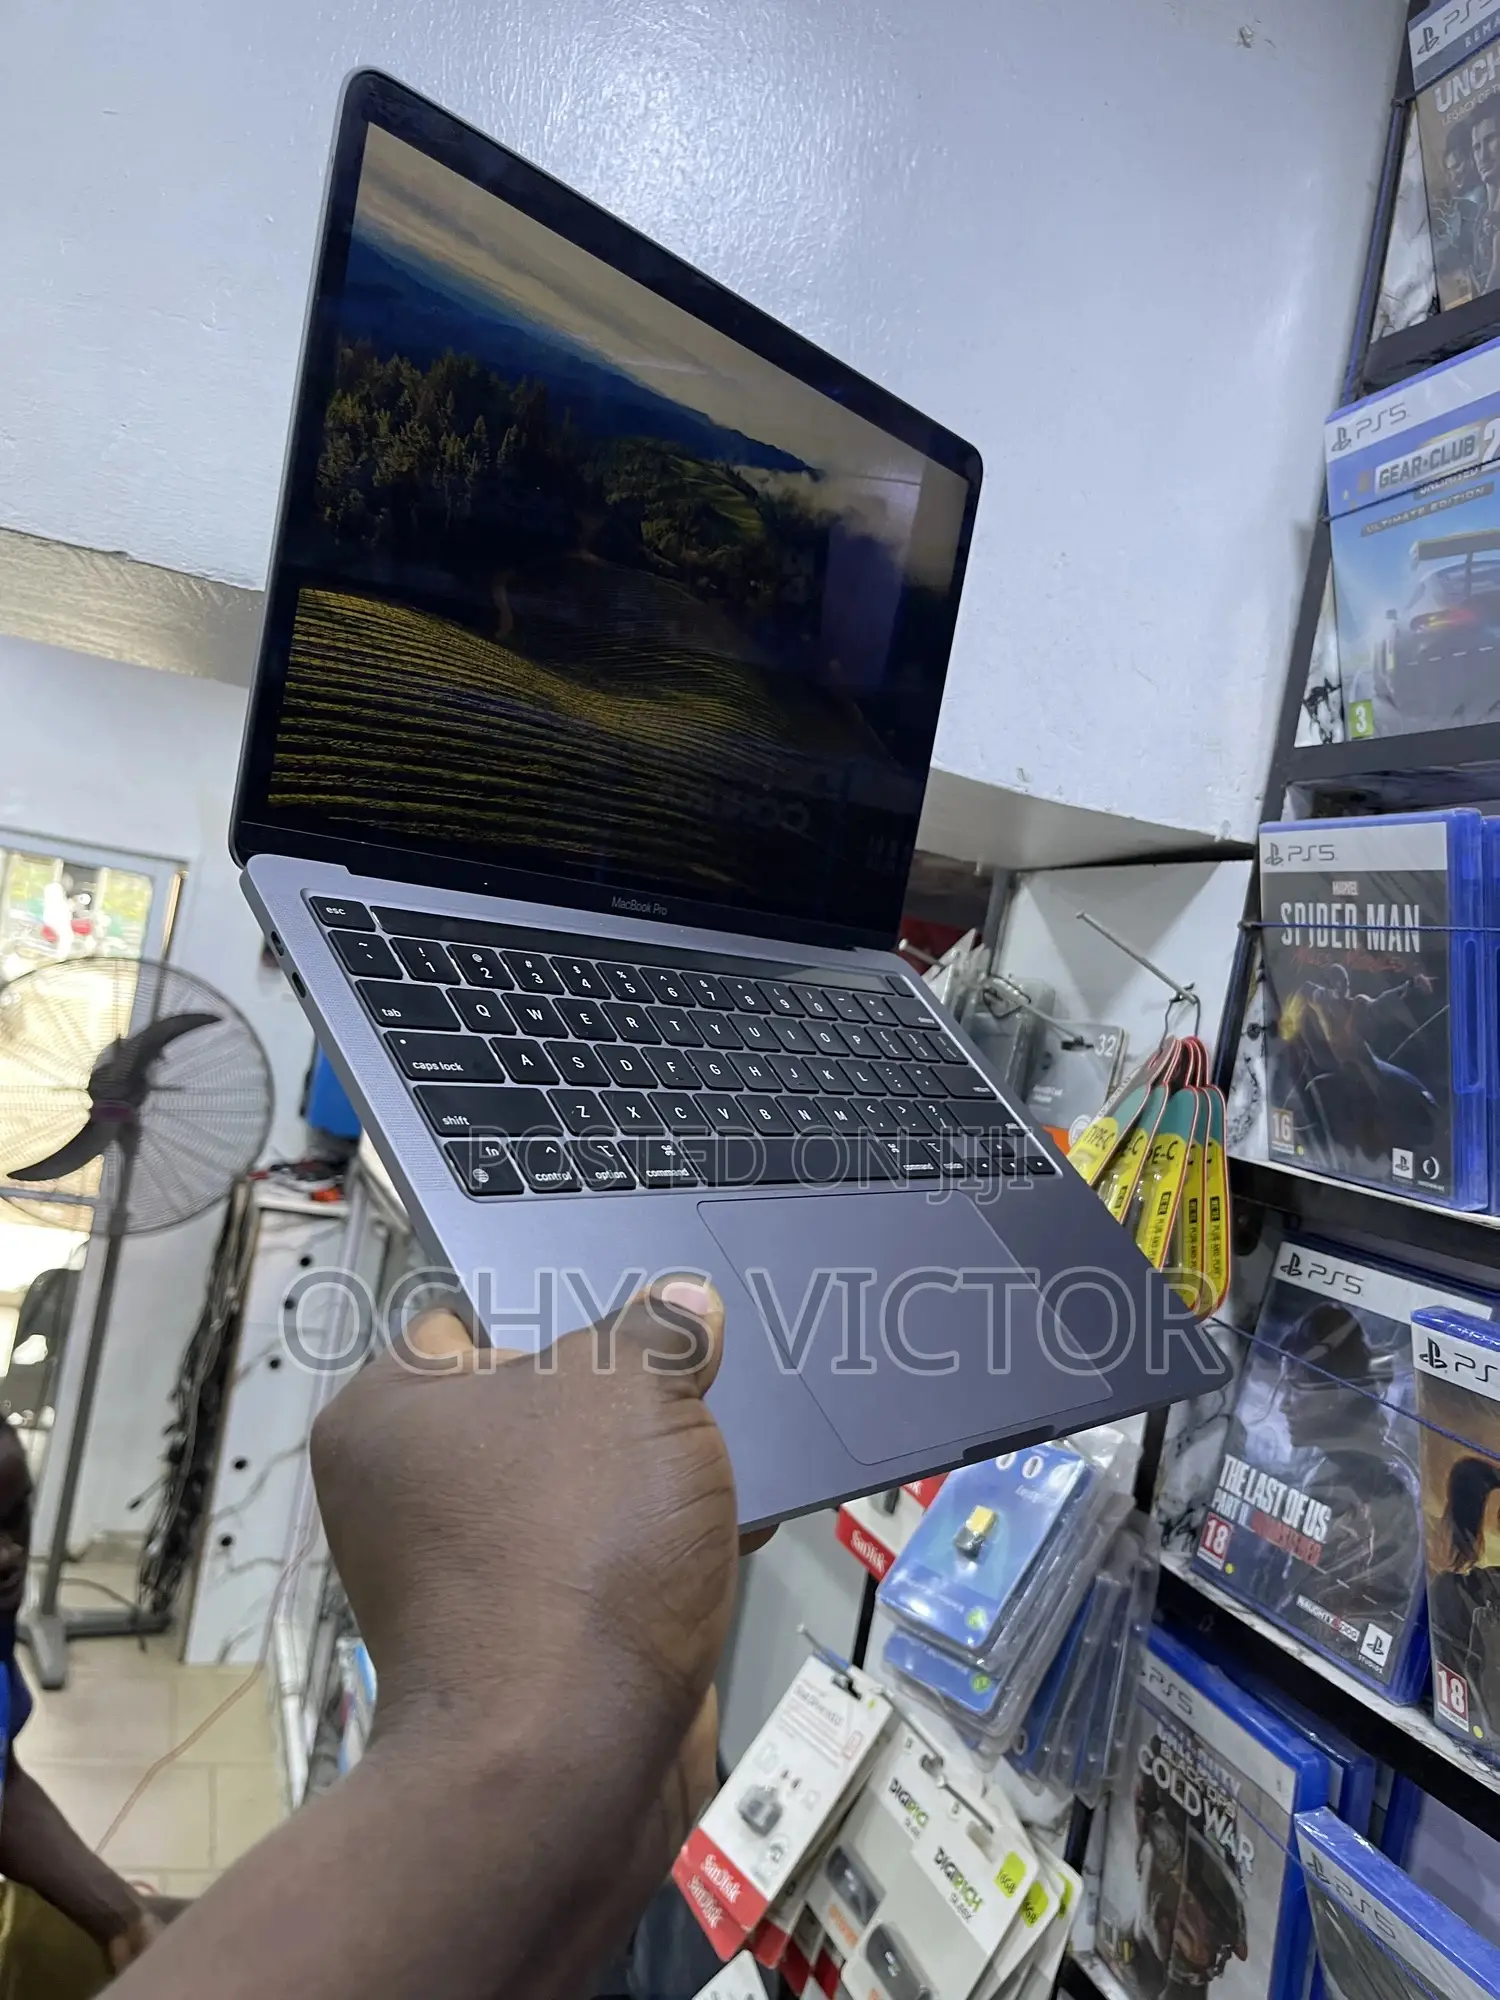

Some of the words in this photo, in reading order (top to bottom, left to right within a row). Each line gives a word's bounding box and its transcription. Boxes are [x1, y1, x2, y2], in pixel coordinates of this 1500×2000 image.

[1356, 402, 1407, 439] PS5
[1366, 506, 1425, 533] ULTIMATE
[1430, 487, 1485, 511] EDITION
[1355, 703, 1366, 734] 3
[1288, 844, 1335, 861] PS5
[1332, 881, 1358, 896] MARVEL
[612, 896, 651, 913] MacBook
[652, 903, 668, 916] Pro
[426, 962, 435, 972] 1
[481, 968, 493, 978] 2
[532, 973, 543, 983] 3
[582, 979, 591, 988] 4
[625, 983, 635, 993] 5
[668, 988, 677, 997] 6
[707, 992, 715, 1000] 7
[745, 996, 754, 1005] 8
[780, 1000, 789, 1008] 9
[382, 1009, 401, 1017] tab
[476, 1005, 491, 1017] Q
[527, 1009, 542, 1020] W
[580, 1014, 592, 1024] E
[626, 1017, 639, 1027] R
[670, 1021, 680, 1030] T
[710, 1025, 720, 1034] Y
[749, 1028, 760, 1037] U
[820, 1033, 830, 1042] O
[853, 1036, 860, 1044] P
[1095, 1034, 1116, 1057] 32
[521, 1054, 533, 1065] A
[572, 1057, 584, 1068] S
[412, 1061, 438, 1072] caps
[440, 1060, 464, 1072] lock
[620, 1060, 632, 1070] D
[667, 1062, 675, 1072] F
[710, 1064, 721, 1074] G
[749, 1067, 761, 1076] H
[791, 1068, 798, 1078] J
[823, 1070, 834, 1079] K
[857, 1072, 867, 1081] L
[576, 1106, 590, 1117] Z
[627, 1107, 640, 1118] X
[675, 1107, 686, 1118] C
[718, 1108, 728, 1119] V
[759, 1109, 771, 1119] B
[798, 1110, 811, 1120] N
[834, 1111, 847, 1120] M
[442, 1116, 469, 1125] shift
[1272, 1112, 1291, 1142] 16
[485, 1146, 499, 1156] fn
[535, 1172, 572, 1181] control
[595, 1170, 626, 1180] option
[646, 1168, 690, 1177] command
[1308, 1263, 1363, 1295] PS5
[1454, 1353, 1498, 1382] PS
[1219, 1453, 1250, 1497] THE
[1244, 1469, 1288, 1518] LAST
[1282, 1488, 1309, 1530] OF
[1303, 1498, 1332, 1543] US
[1204, 1520, 1229, 1555] 18
[1149, 1666, 1193, 1716] PS5
[1438, 1670, 1465, 1714] 18
[1138, 1743, 1202, 1817] COLD
[1203, 1798, 1255, 1874] WAR
[701, 1854, 743, 1905] SanDisk
[1334, 1875, 1396, 1940] PS5
